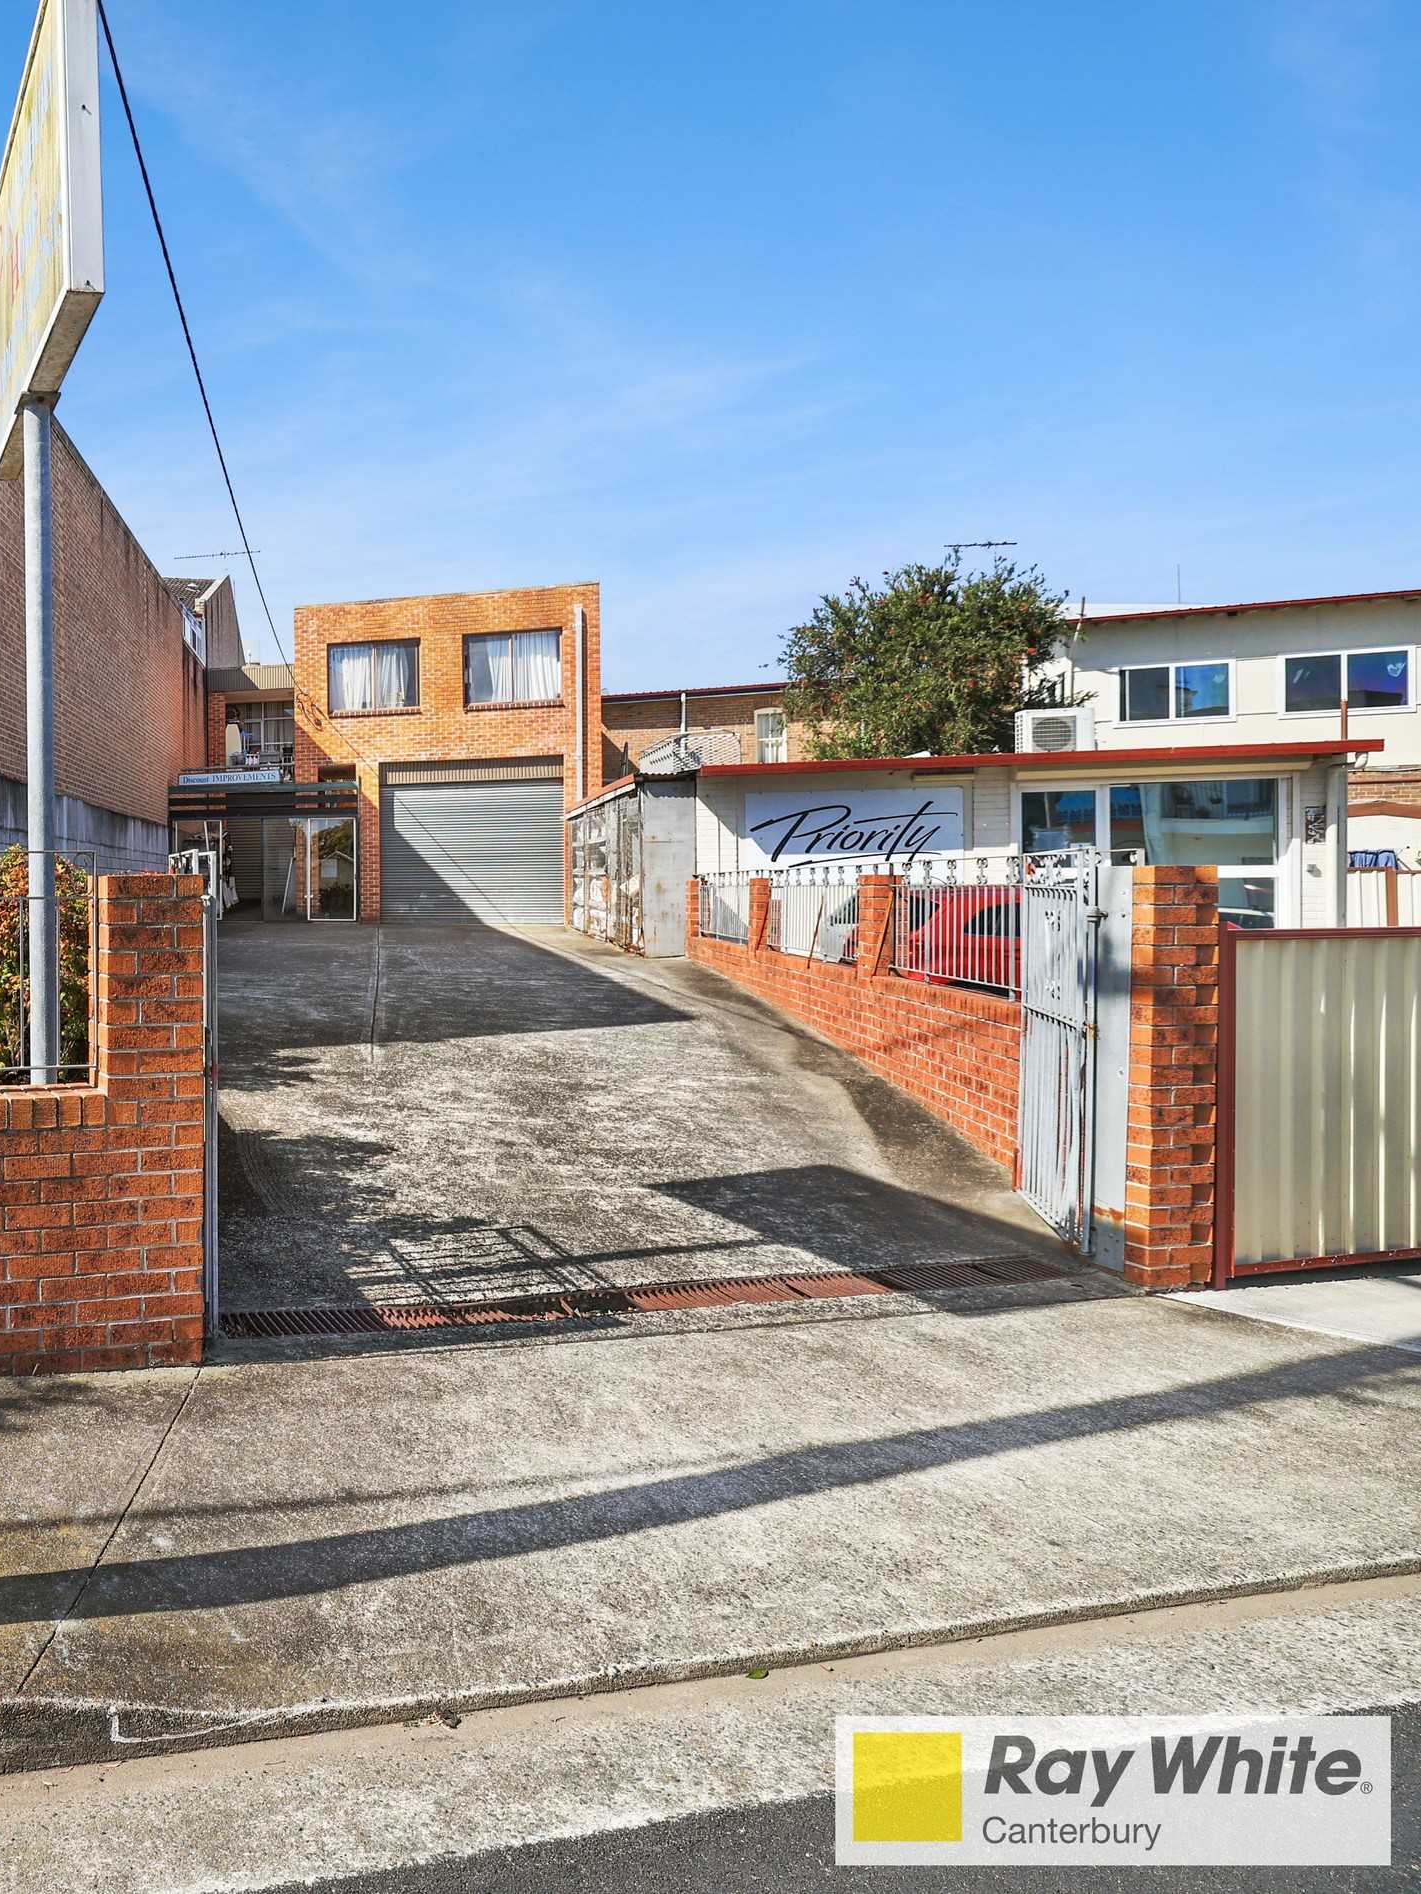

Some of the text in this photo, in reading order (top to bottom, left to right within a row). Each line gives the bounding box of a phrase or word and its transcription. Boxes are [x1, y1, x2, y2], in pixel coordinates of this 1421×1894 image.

[183, 772, 276, 784] Discount IMPROVEMENTS
[750, 800, 958, 866] Priority
